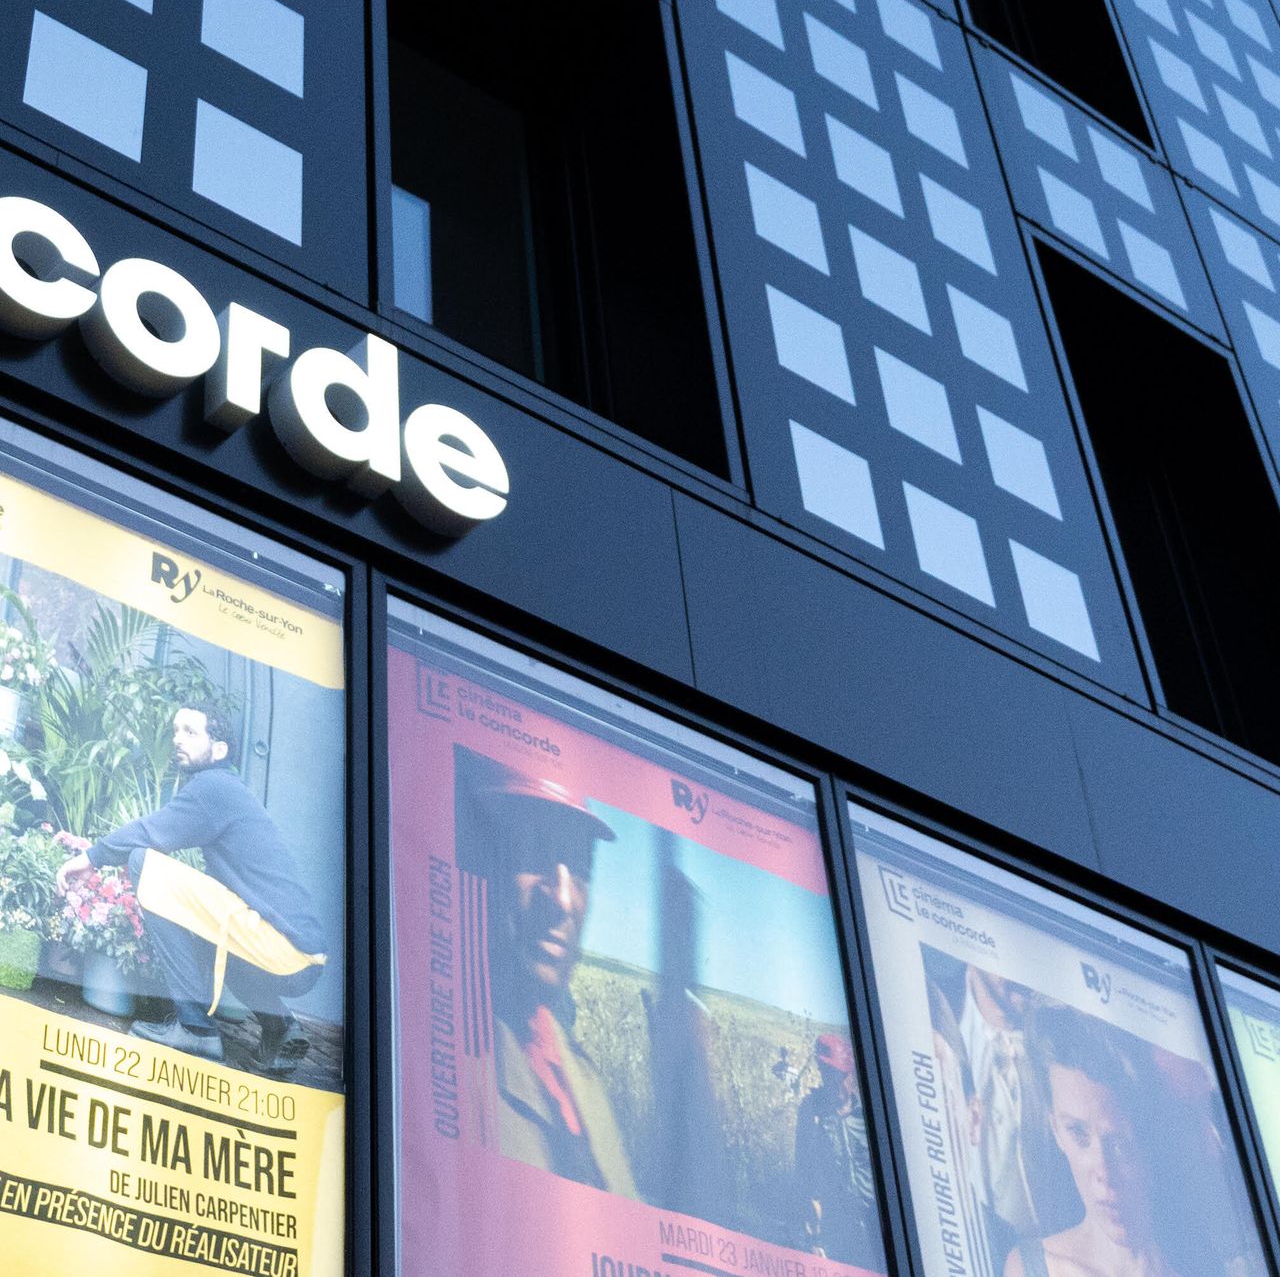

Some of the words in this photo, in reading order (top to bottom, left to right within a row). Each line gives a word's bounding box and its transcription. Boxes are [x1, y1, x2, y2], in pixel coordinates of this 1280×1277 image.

[479, 714, 561, 757] concorde
[429, 855, 453, 924] FOCH
[430, 930, 454, 979] RUE
[42, 1024, 107, 1069] LUNDI
[113, 1046, 141, 1078] 22
[146, 1057, 231, 1107] JANVIER
[236, 1085, 297, 1122] 21:00
[430, 980, 460, 1139] OUVERTURE
[912, 1050, 939, 1113] FOCH
[26, 1078, 80, 1141] VIE
[87, 1098, 130, 1157] DE
[140, 1118, 193, 1176] MA
[202, 1129, 298, 1199] MÈRE
[921, 1115, 946, 1164] RUE
[1, 1182, 31, 1213] EN
[33, 1187, 136, 1242] PRÉSENCE
[137, 1219, 169, 1250] DU
[169, 1223, 298, 1277] RÉALISATEUR
[109, 1169, 131, 1198] DE
[134, 1175, 191, 1212] JULIEN
[195, 1192, 298, 1239] CARPENTIER
[659, 1220, 714, 1256] MARDI
[719, 1236, 737, 1266] 23
[742, 1246, 807, 1277] JANVIER
